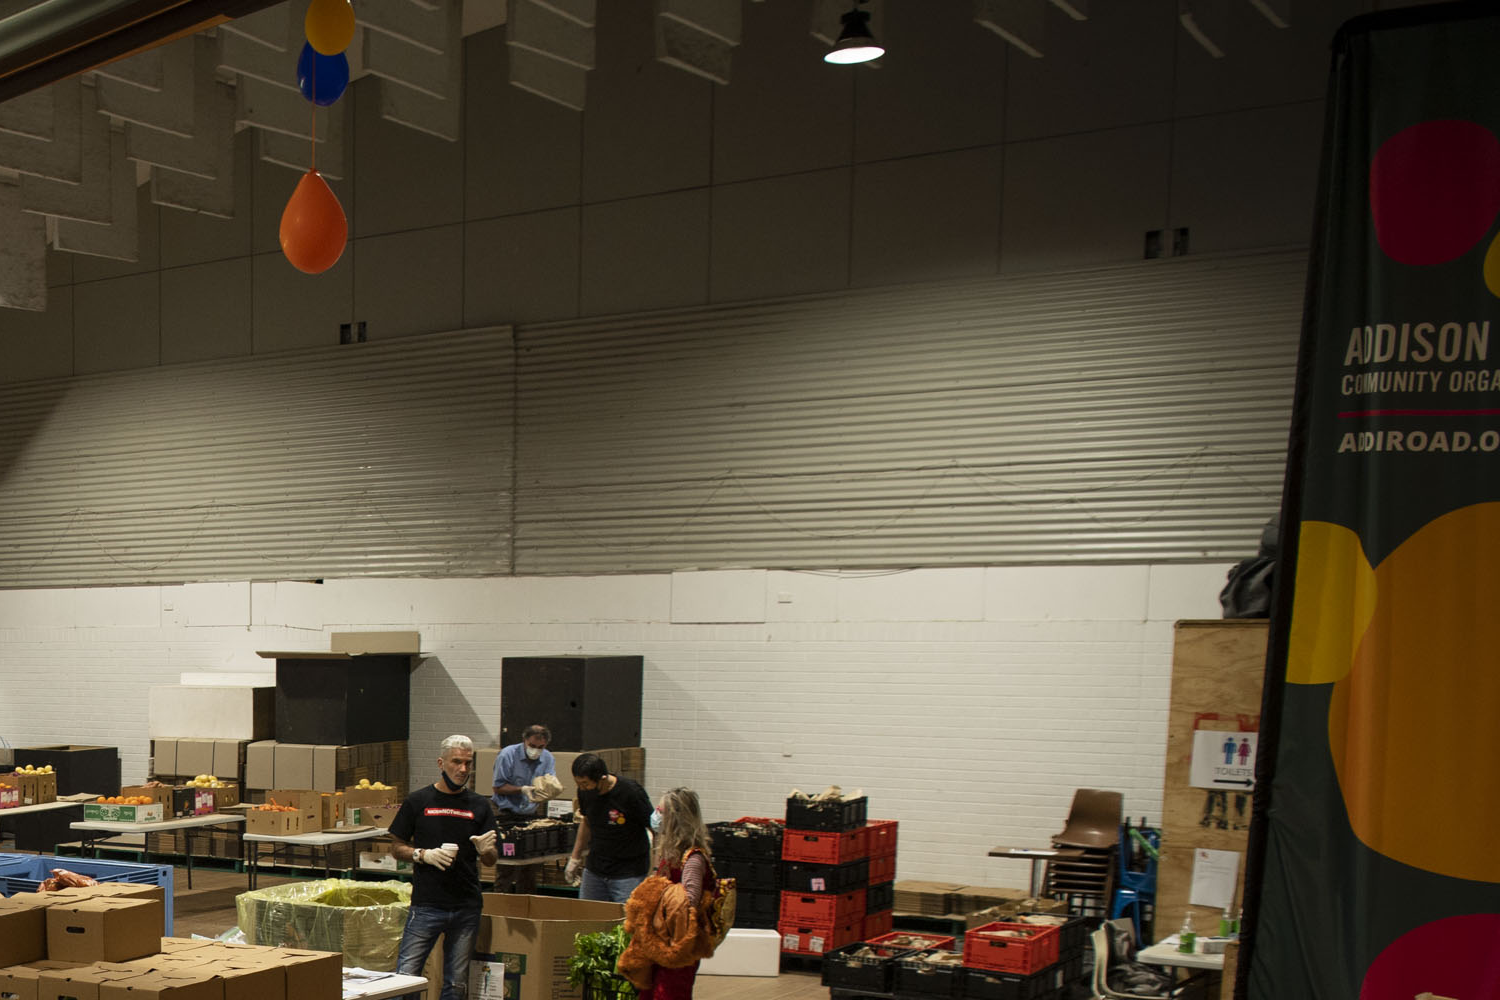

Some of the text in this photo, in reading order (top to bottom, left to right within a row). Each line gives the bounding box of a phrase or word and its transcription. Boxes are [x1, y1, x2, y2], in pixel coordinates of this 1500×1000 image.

[1343, 320, 1491, 367] ADDISON
[1341, 370, 1443, 396] COMMUNITY
[1215, 767, 1253, 777] TOILETS
